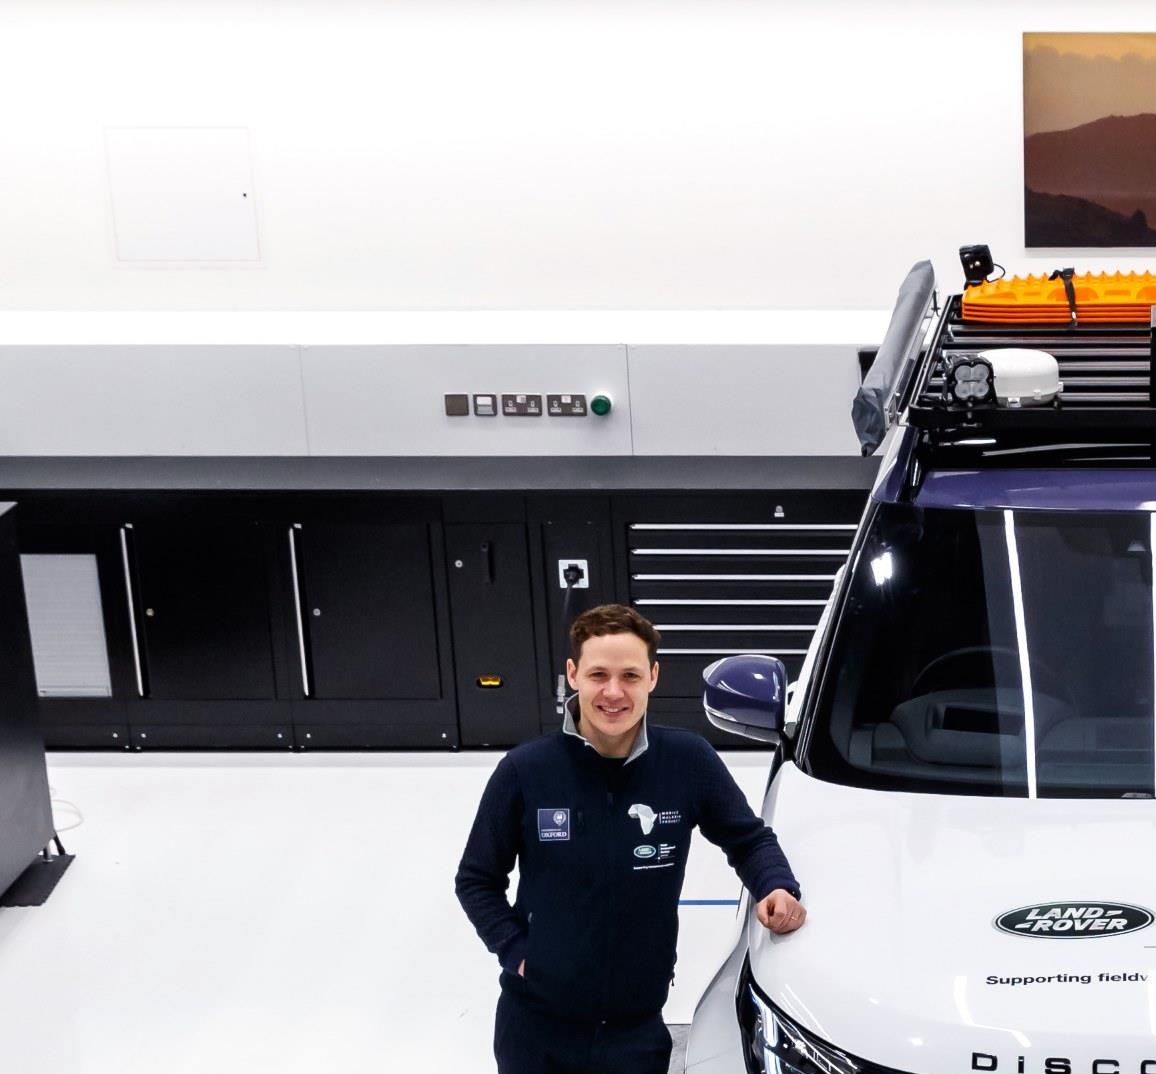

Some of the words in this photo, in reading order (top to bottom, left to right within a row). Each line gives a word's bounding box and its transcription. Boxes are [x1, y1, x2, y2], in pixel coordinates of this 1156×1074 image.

[1024, 906, 1106, 920] LAND
[1030, 918, 1128, 932] ROVER
[985, 972, 1092, 986] Supporting
